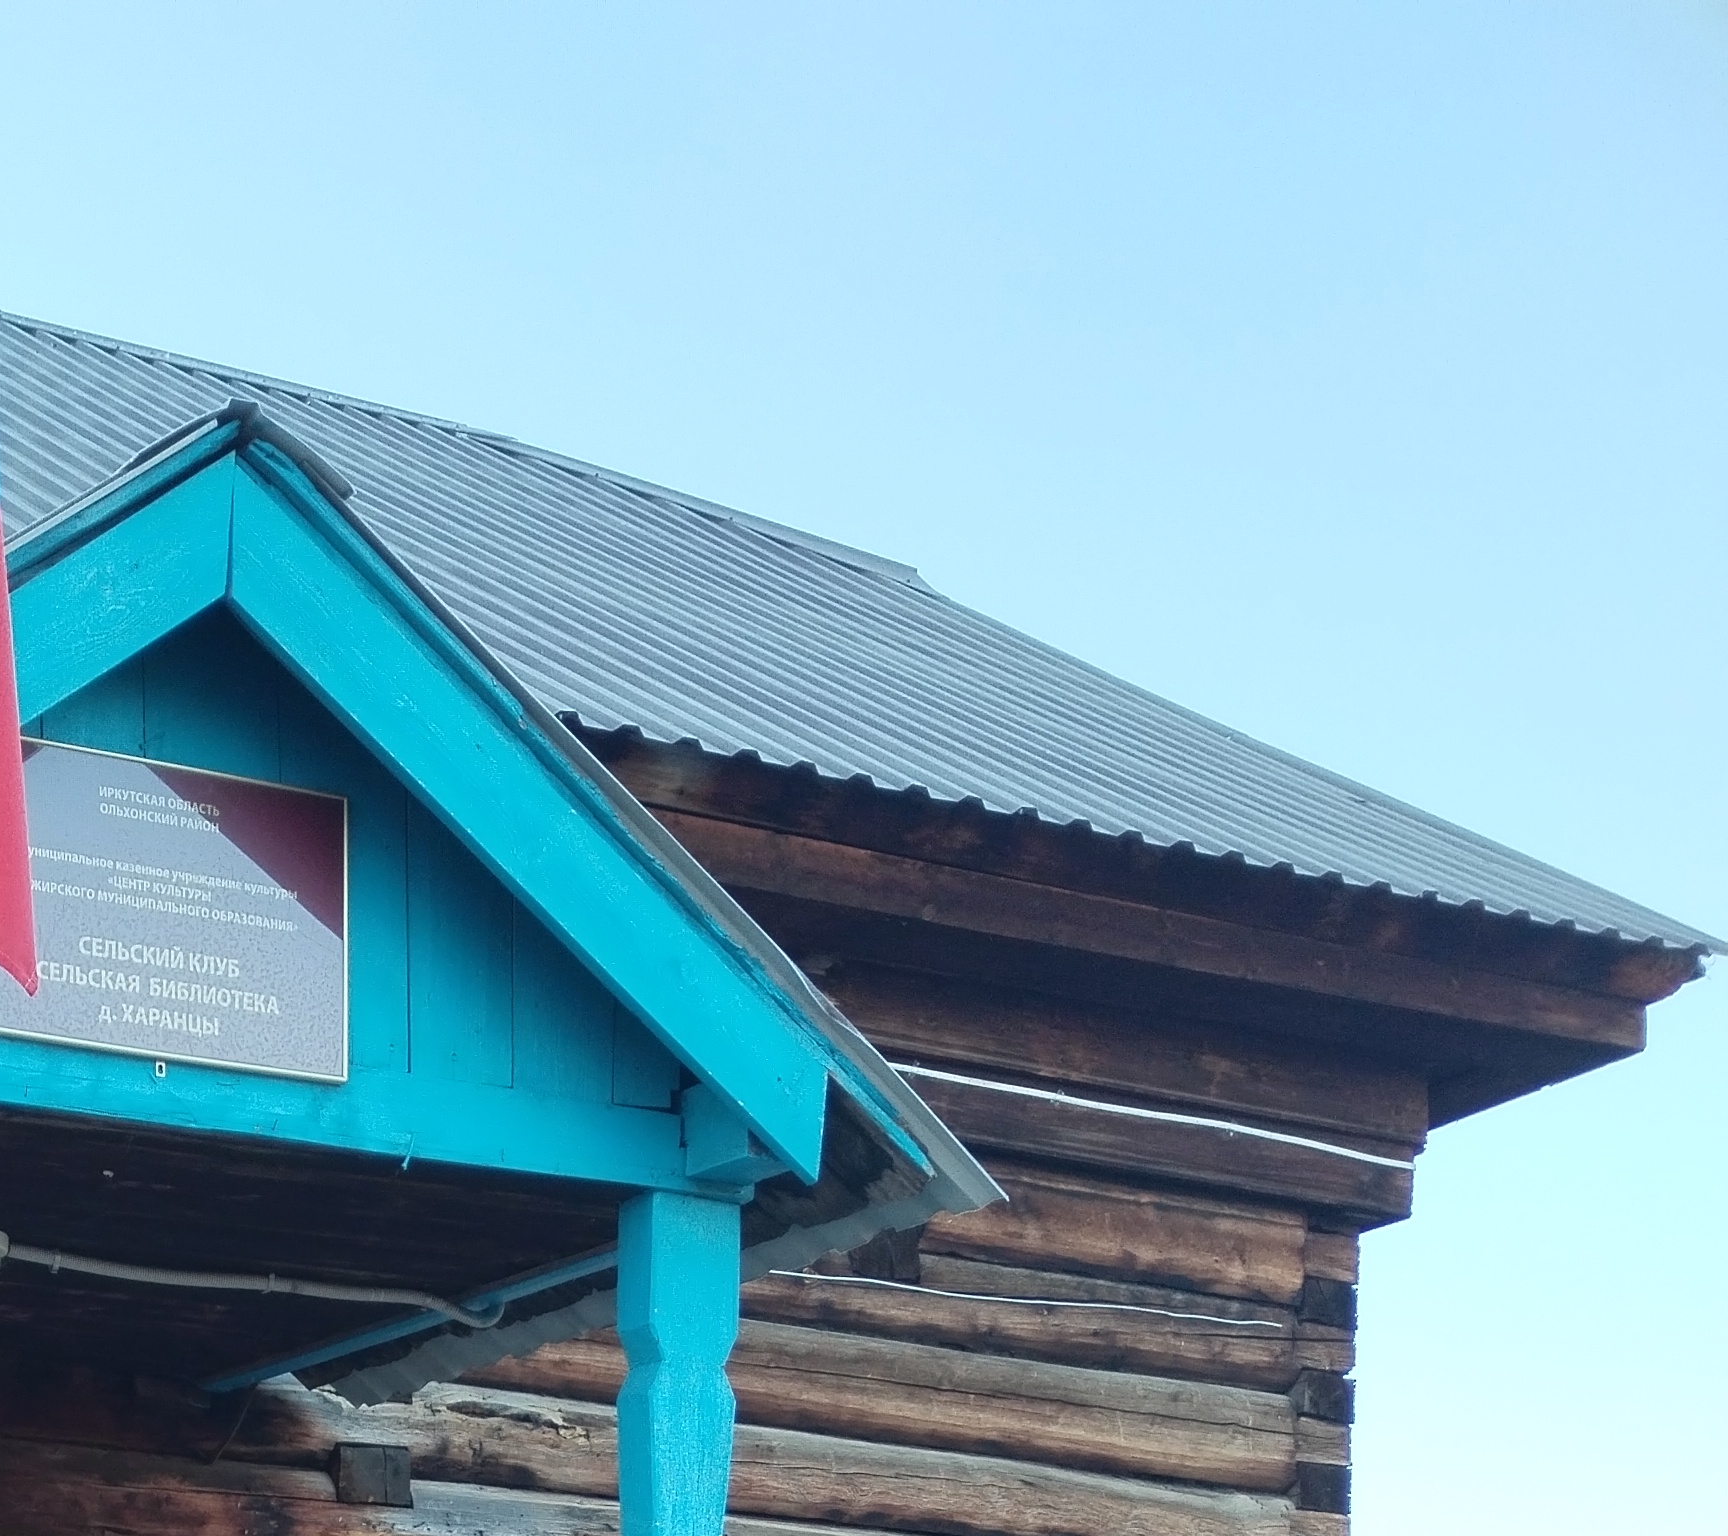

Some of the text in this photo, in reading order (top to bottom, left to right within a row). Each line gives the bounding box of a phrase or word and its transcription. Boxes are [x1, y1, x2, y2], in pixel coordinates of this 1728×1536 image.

[99, 785, 220, 817] ИРКУТСКАЯ ОБЛАСТЬ
[100, 802, 220, 834] ОЛЬХОНСКИЙ РАЙОН
[28, 846, 298, 901] униципальное казенное учреждение культуры
[108, 875, 212, 903] «ЦЕНТР КУЛЬТУРЫ
[31, 879, 299, 933] ЖИРСКОГО МУНИЦИПАЛЬНОГО ОБРАЗОВАНИЯ»
[78, 936, 240, 979] СЕЛЬСКИЙ КЛУБ
[37, 960, 280, 1015] СЕЛЬСКАЯ БИБЛИОТЕКА
[98, 1003, 219, 1038] д. ХАРАНЦЫ
